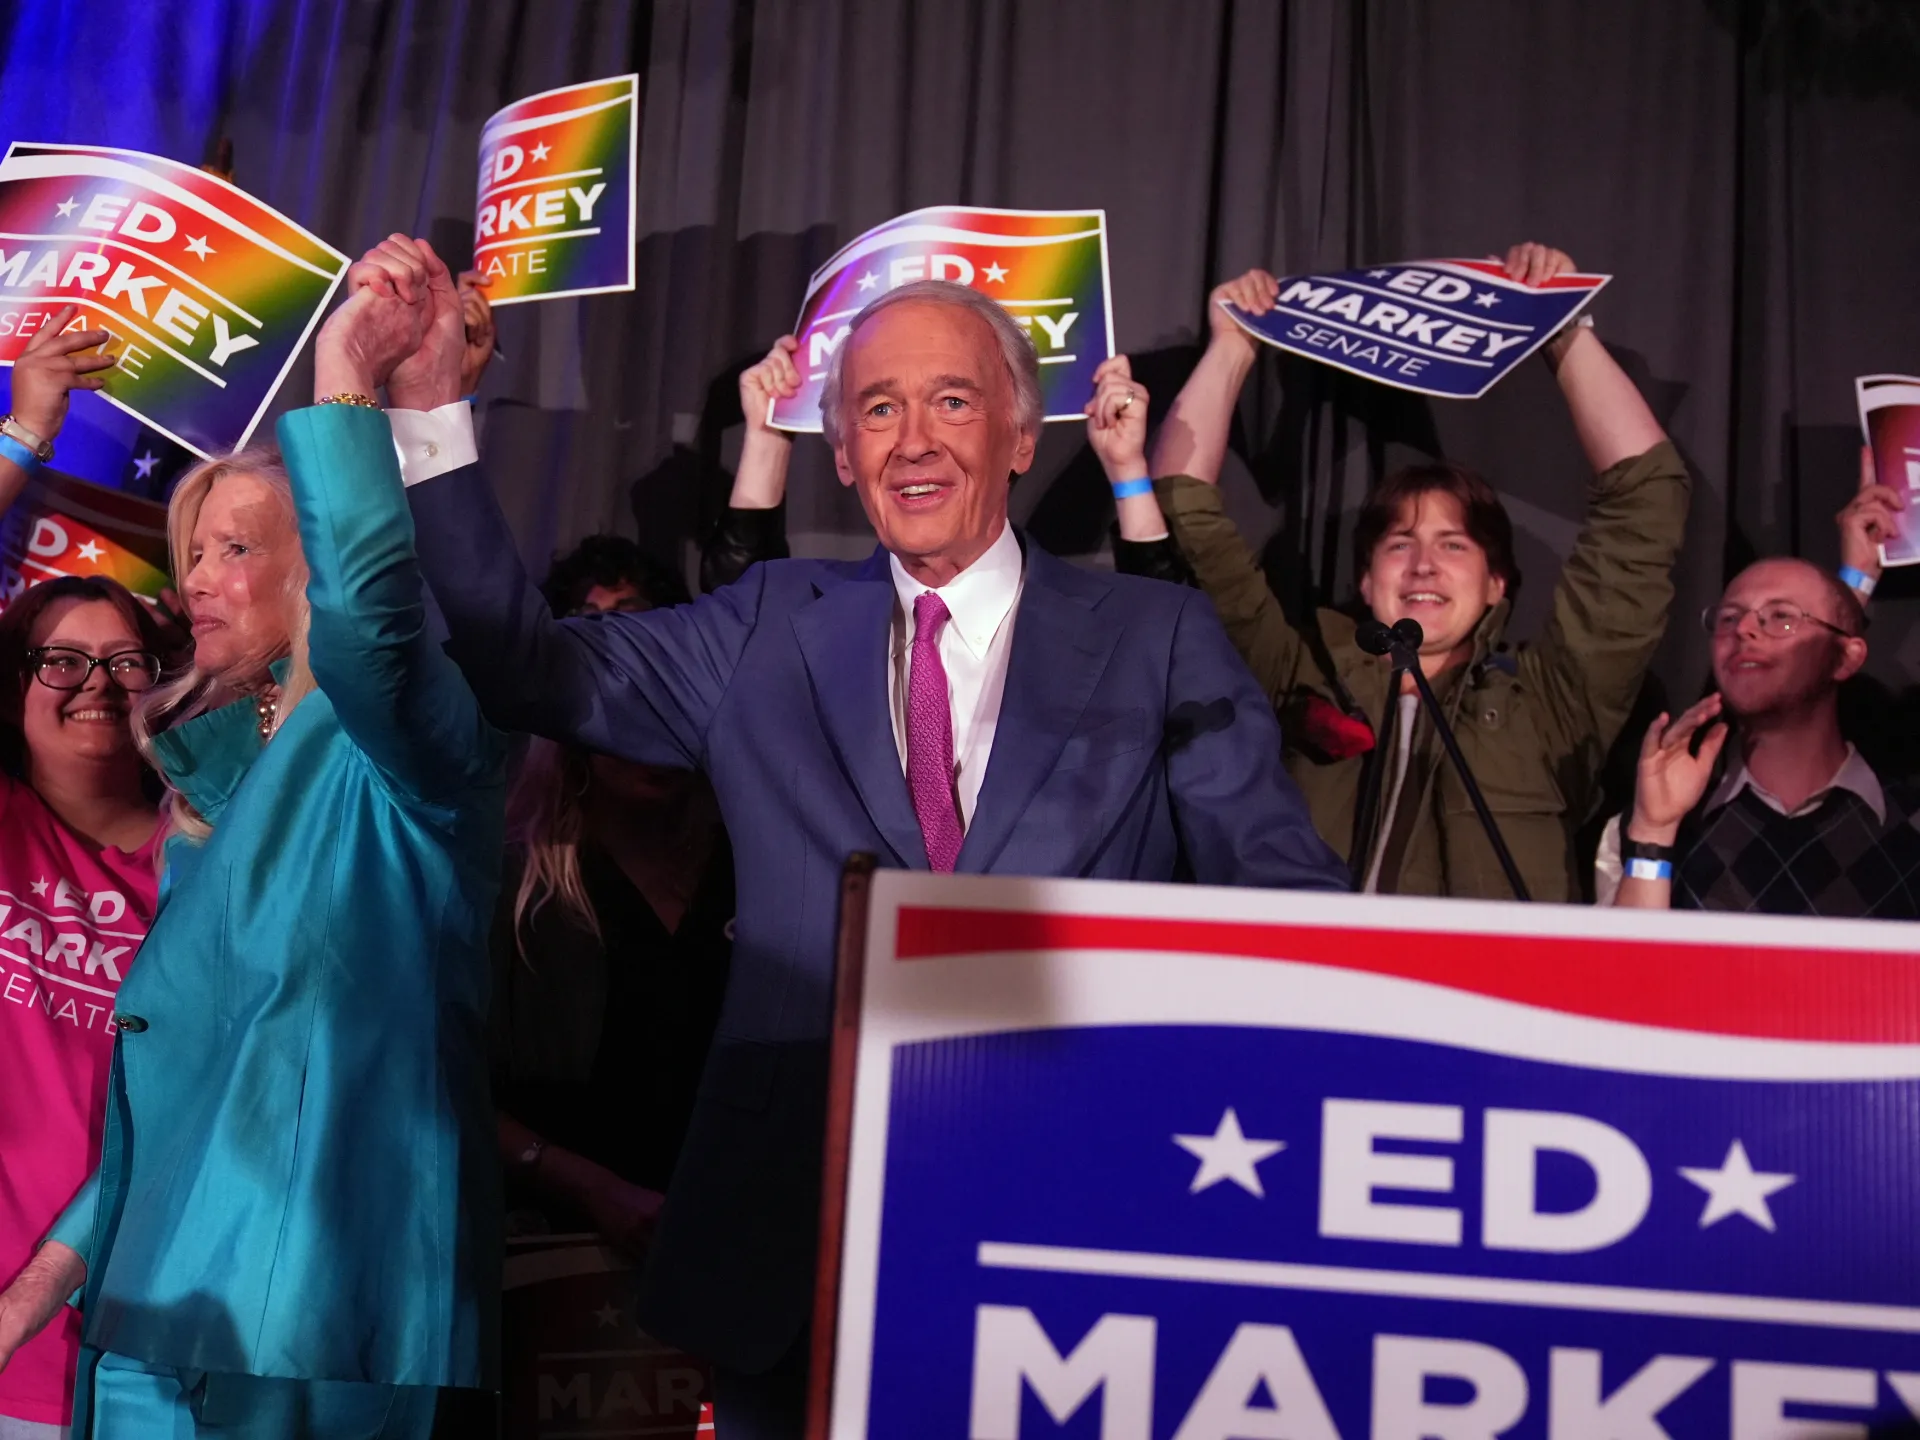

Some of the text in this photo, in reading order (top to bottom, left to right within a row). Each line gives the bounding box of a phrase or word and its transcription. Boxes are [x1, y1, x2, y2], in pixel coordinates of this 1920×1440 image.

[78, 193, 177, 243] ED
[476, 183, 606, 241] RKEY
[478, 249, 547, 277] ATE
[1386, 269, 1471, 302] ED
[1278, 281, 1528, 358] MARKEY
[1287, 322, 1430, 377] SENATE
[54, 876, 126, 924] ED
[0, 904, 132, 982] ARK
[0, 966, 117, 1036] ENATE
[1318, 1097, 1652, 1254] ED
[537, 1368, 708, 1421] MAR
[968, 1303, 1920, 1440] MARKE
